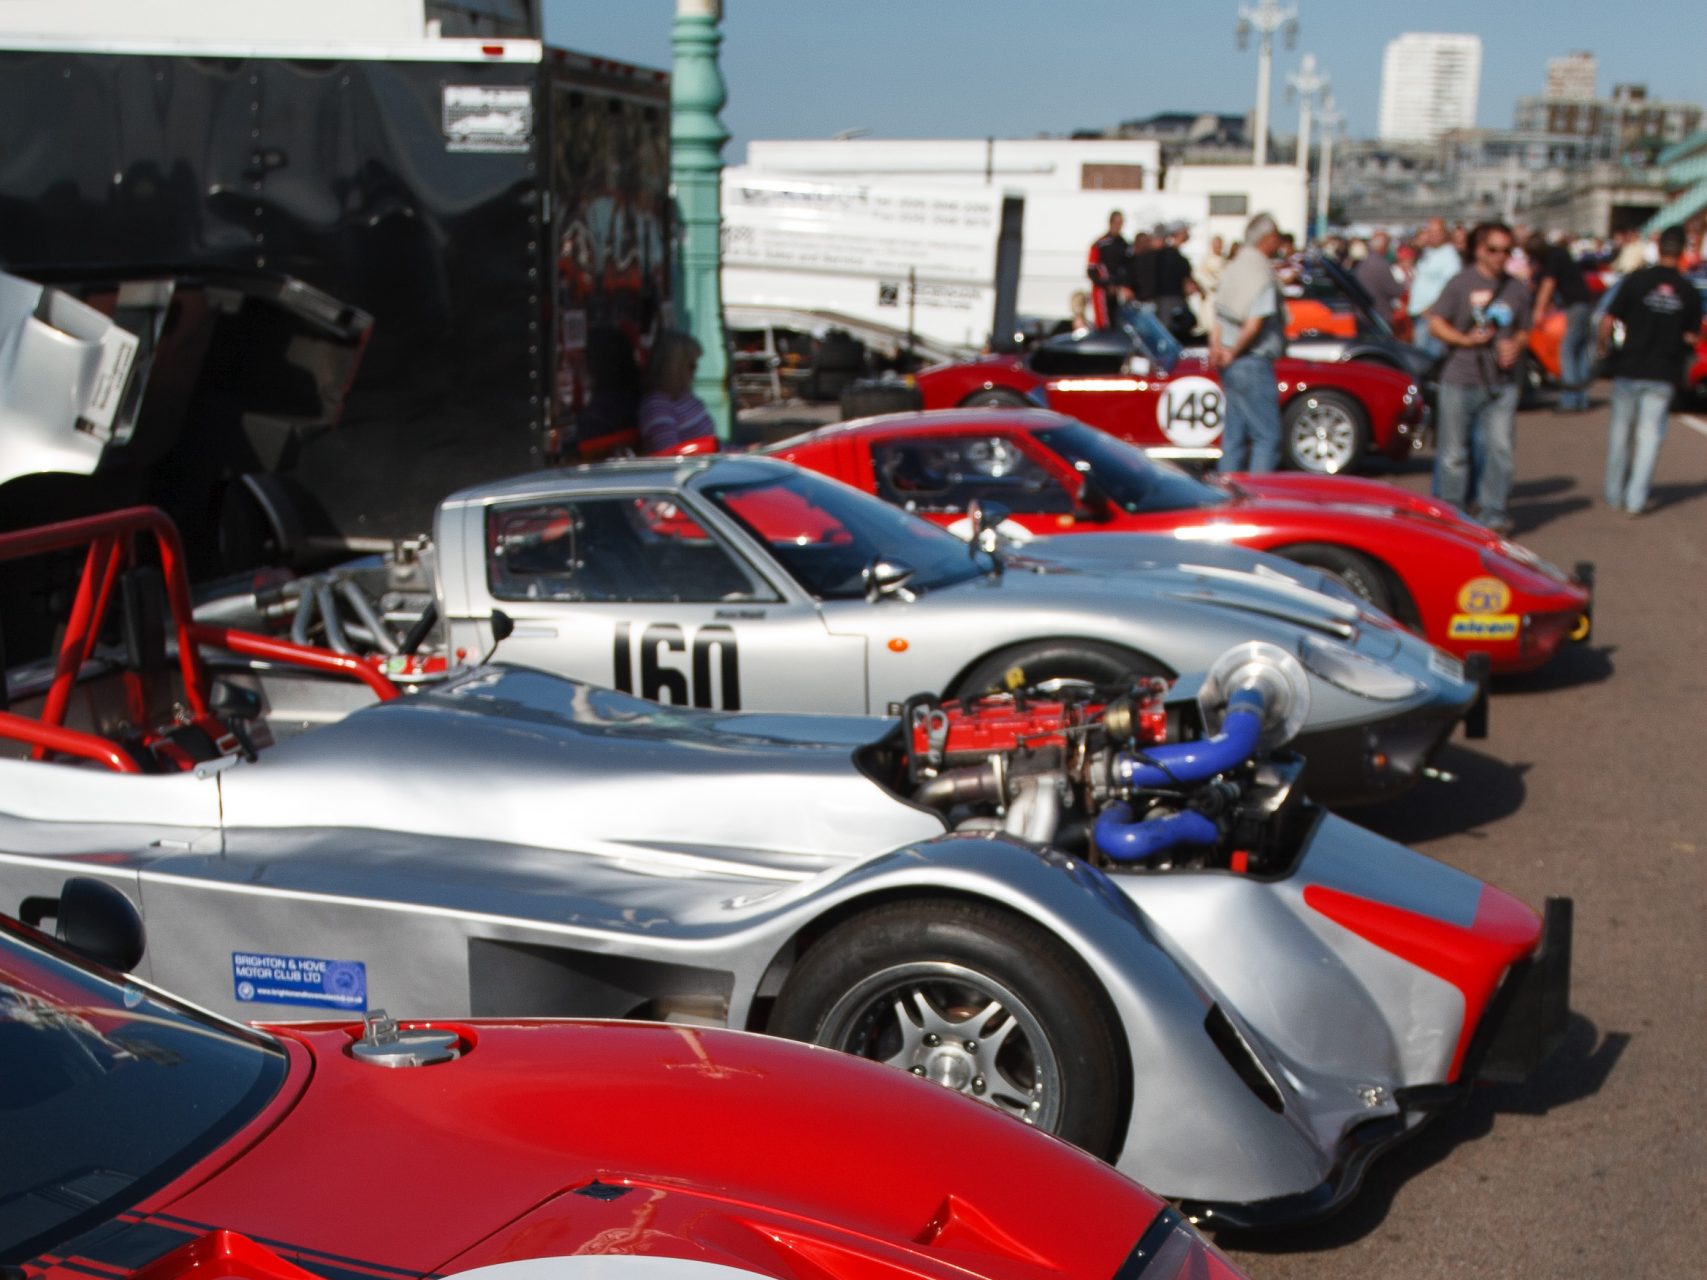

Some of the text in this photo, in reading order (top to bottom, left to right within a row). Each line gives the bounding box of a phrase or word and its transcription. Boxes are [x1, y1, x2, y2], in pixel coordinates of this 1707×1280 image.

[1166, 391, 1219, 429] 148
[613, 621, 742, 711] 160
[234, 954, 327, 972] BRIGHTON & HOVE
[236, 966, 321, 984] MOTOR CLUB LTD
